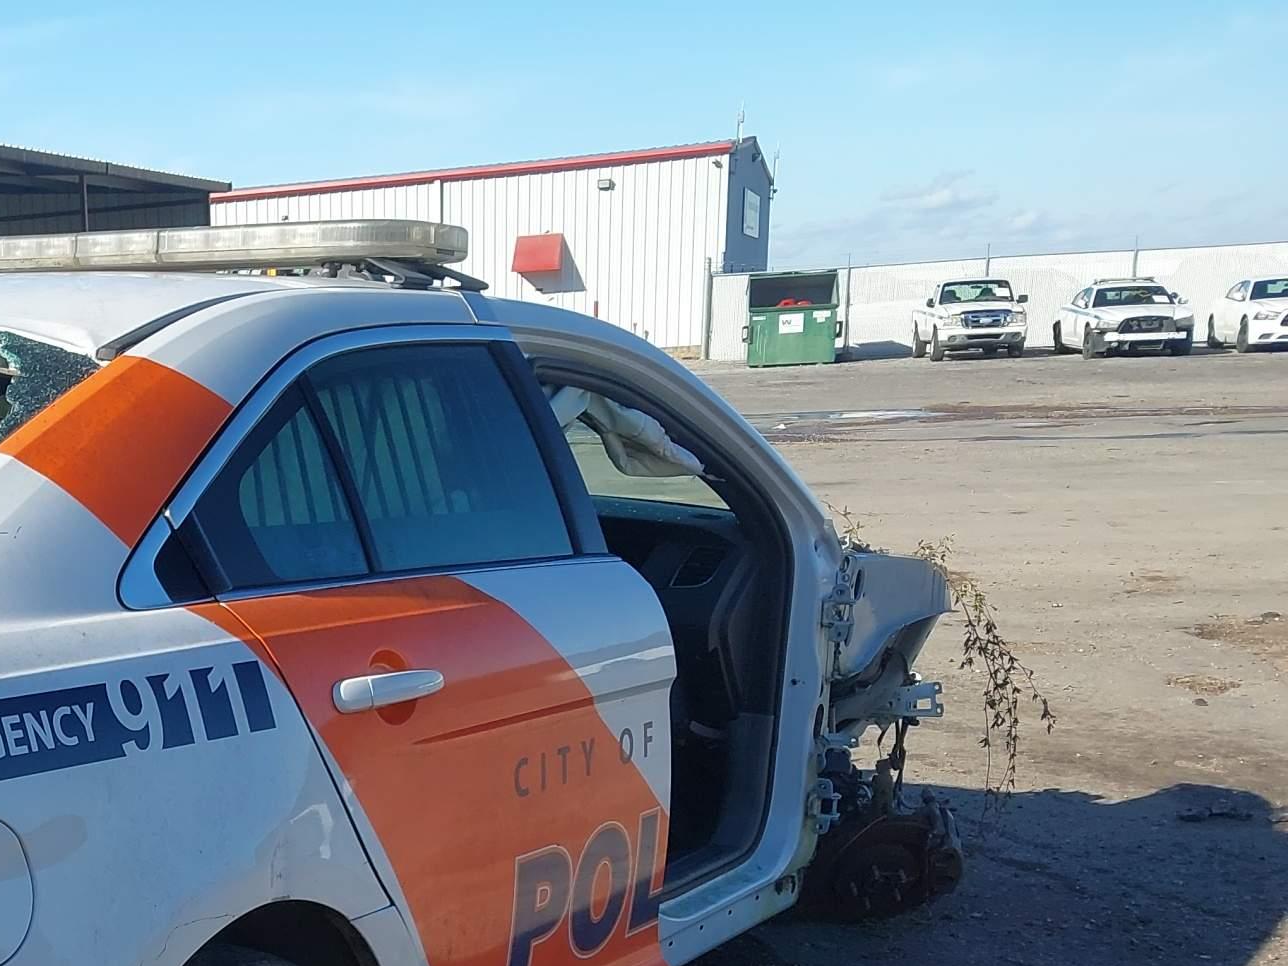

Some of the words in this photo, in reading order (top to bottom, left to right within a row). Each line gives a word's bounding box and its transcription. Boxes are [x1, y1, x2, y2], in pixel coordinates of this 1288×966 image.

[105, 664, 252, 753] 911
[513, 737, 596, 797] CITY
[618, 720, 654, 765] OF
